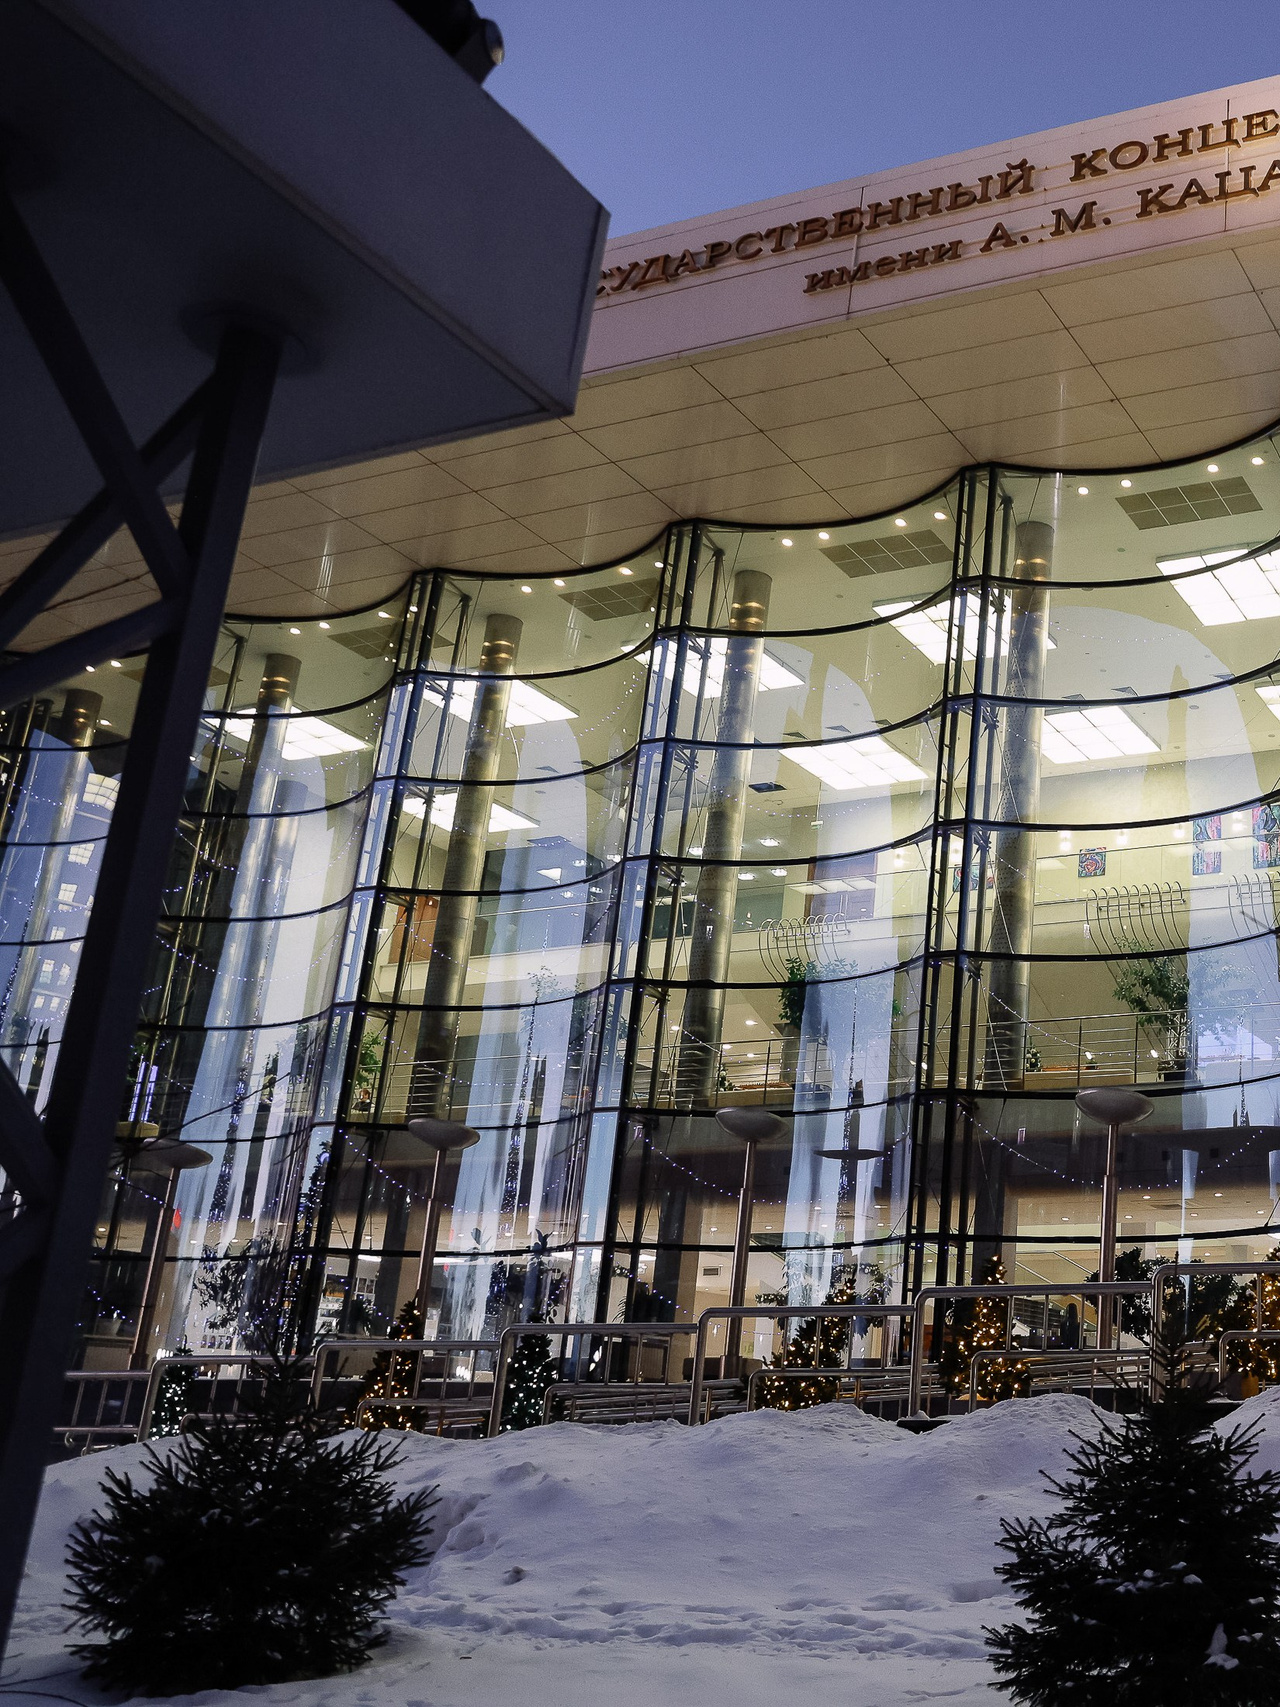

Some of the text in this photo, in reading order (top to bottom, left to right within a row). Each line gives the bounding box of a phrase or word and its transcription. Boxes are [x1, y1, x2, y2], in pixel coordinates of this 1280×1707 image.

[802, 238, 963, 295] имени
[979, 221, 1029, 253] А.
[1048, 200, 1112, 237] М.
